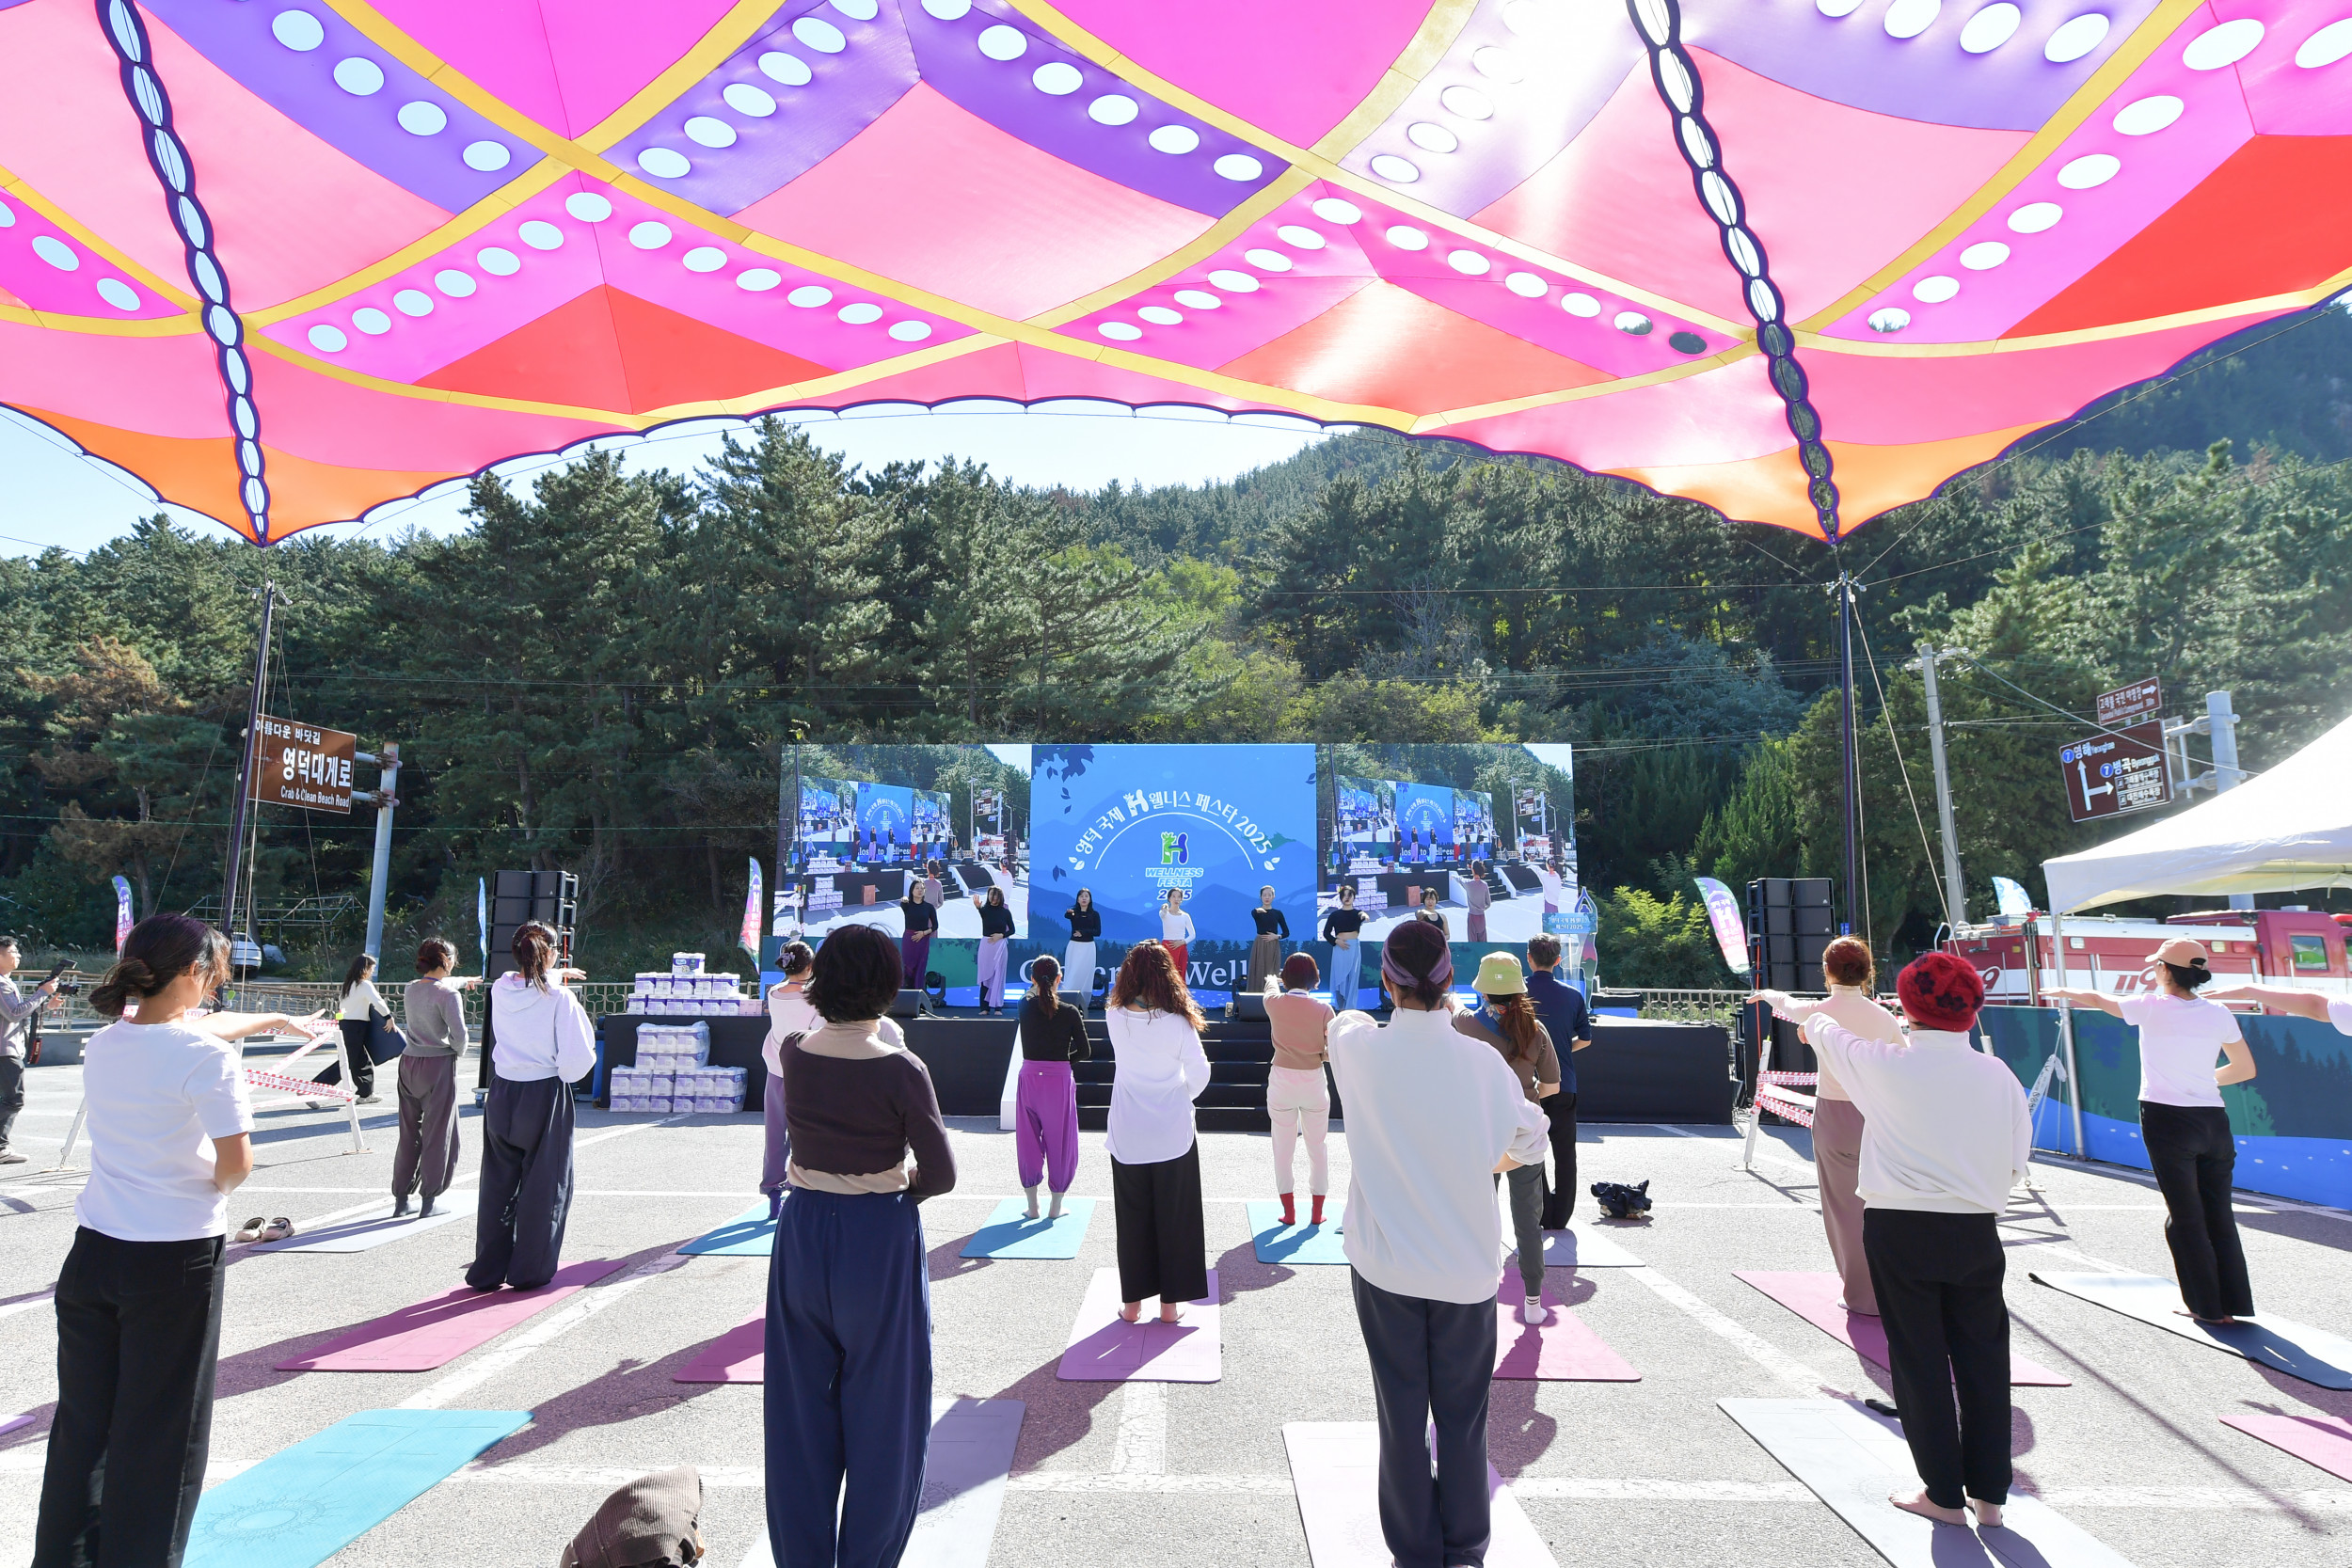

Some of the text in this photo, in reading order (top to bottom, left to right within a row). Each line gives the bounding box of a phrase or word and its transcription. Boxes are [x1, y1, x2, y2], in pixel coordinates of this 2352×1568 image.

[294, 728, 321, 745] 바닷길
[2074, 741, 2092, 759] 영해
[282, 747, 351, 787] 영덕대게로
[2112, 757, 2132, 775] 병곡
[280, 785, 349, 807] Crab & Clean Beach Road
[1075, 827, 1103, 854] 영덕
[1095, 806, 1125, 831] 국제
[1195, 793, 1238, 823] 페스타
[1234, 816, 1273, 854] 2025
[1145, 867, 1203, 878] WELLNESS
[1157, 878, 1192, 888] FESTA
[1157, 889, 1192, 900] 25
[2114, 967, 2158, 993] 119
